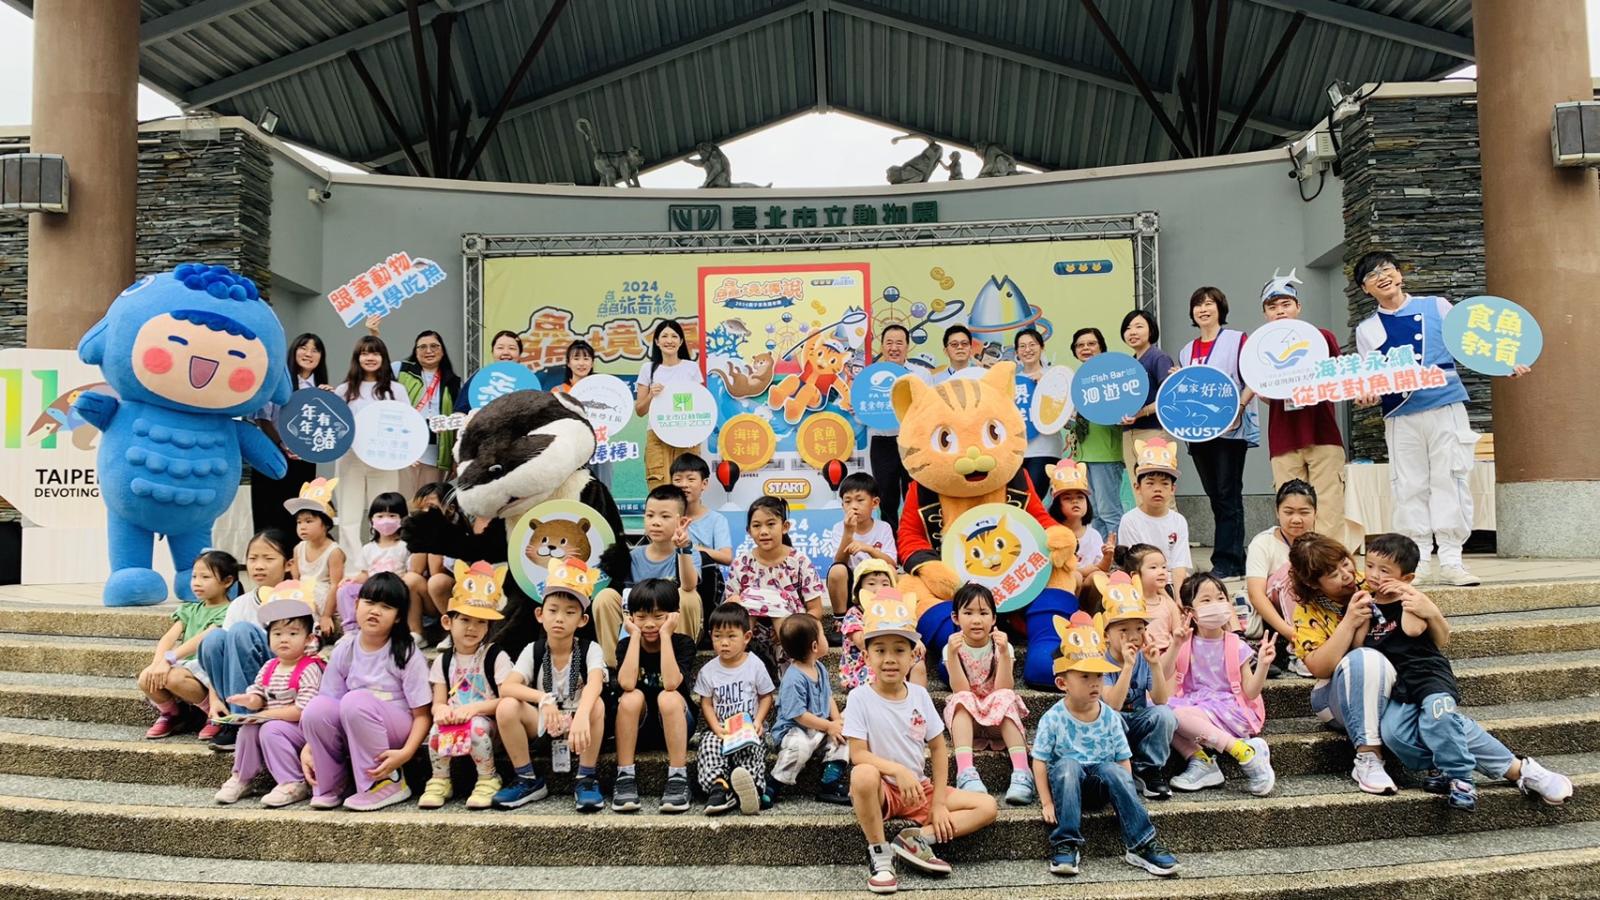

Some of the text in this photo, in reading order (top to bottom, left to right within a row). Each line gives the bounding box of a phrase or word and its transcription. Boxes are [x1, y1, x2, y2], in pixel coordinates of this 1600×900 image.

[732, 201, 938, 229] 臺北市立動物園
[330, 253, 412, 312] 跟著動物
[623, 281, 658, 292] 2024
[347, 264, 445, 326] 一起學吃魚
[1466, 302, 1523, 338] 食魚
[1461, 330, 1521, 366] 教育
[1314, 345, 1415, 378] 海洋永續
[1091, 370, 1126, 383] Fish Bar
[1082, 378, 1141, 406] 洄遊吧
[1292, 366, 1447, 406] 從吃對魚開始
[734, 428, 761, 440] 海洋
[812, 426, 837, 440] 食魚
[1174, 427, 1221, 437] NKUST
[733, 443, 760, 456] 永續
[813, 442, 837, 456] 教育
[34, 488, 99, 497] DEVOTING
[768, 482, 806, 494] START
[713, 681, 743, 704] SPACE
